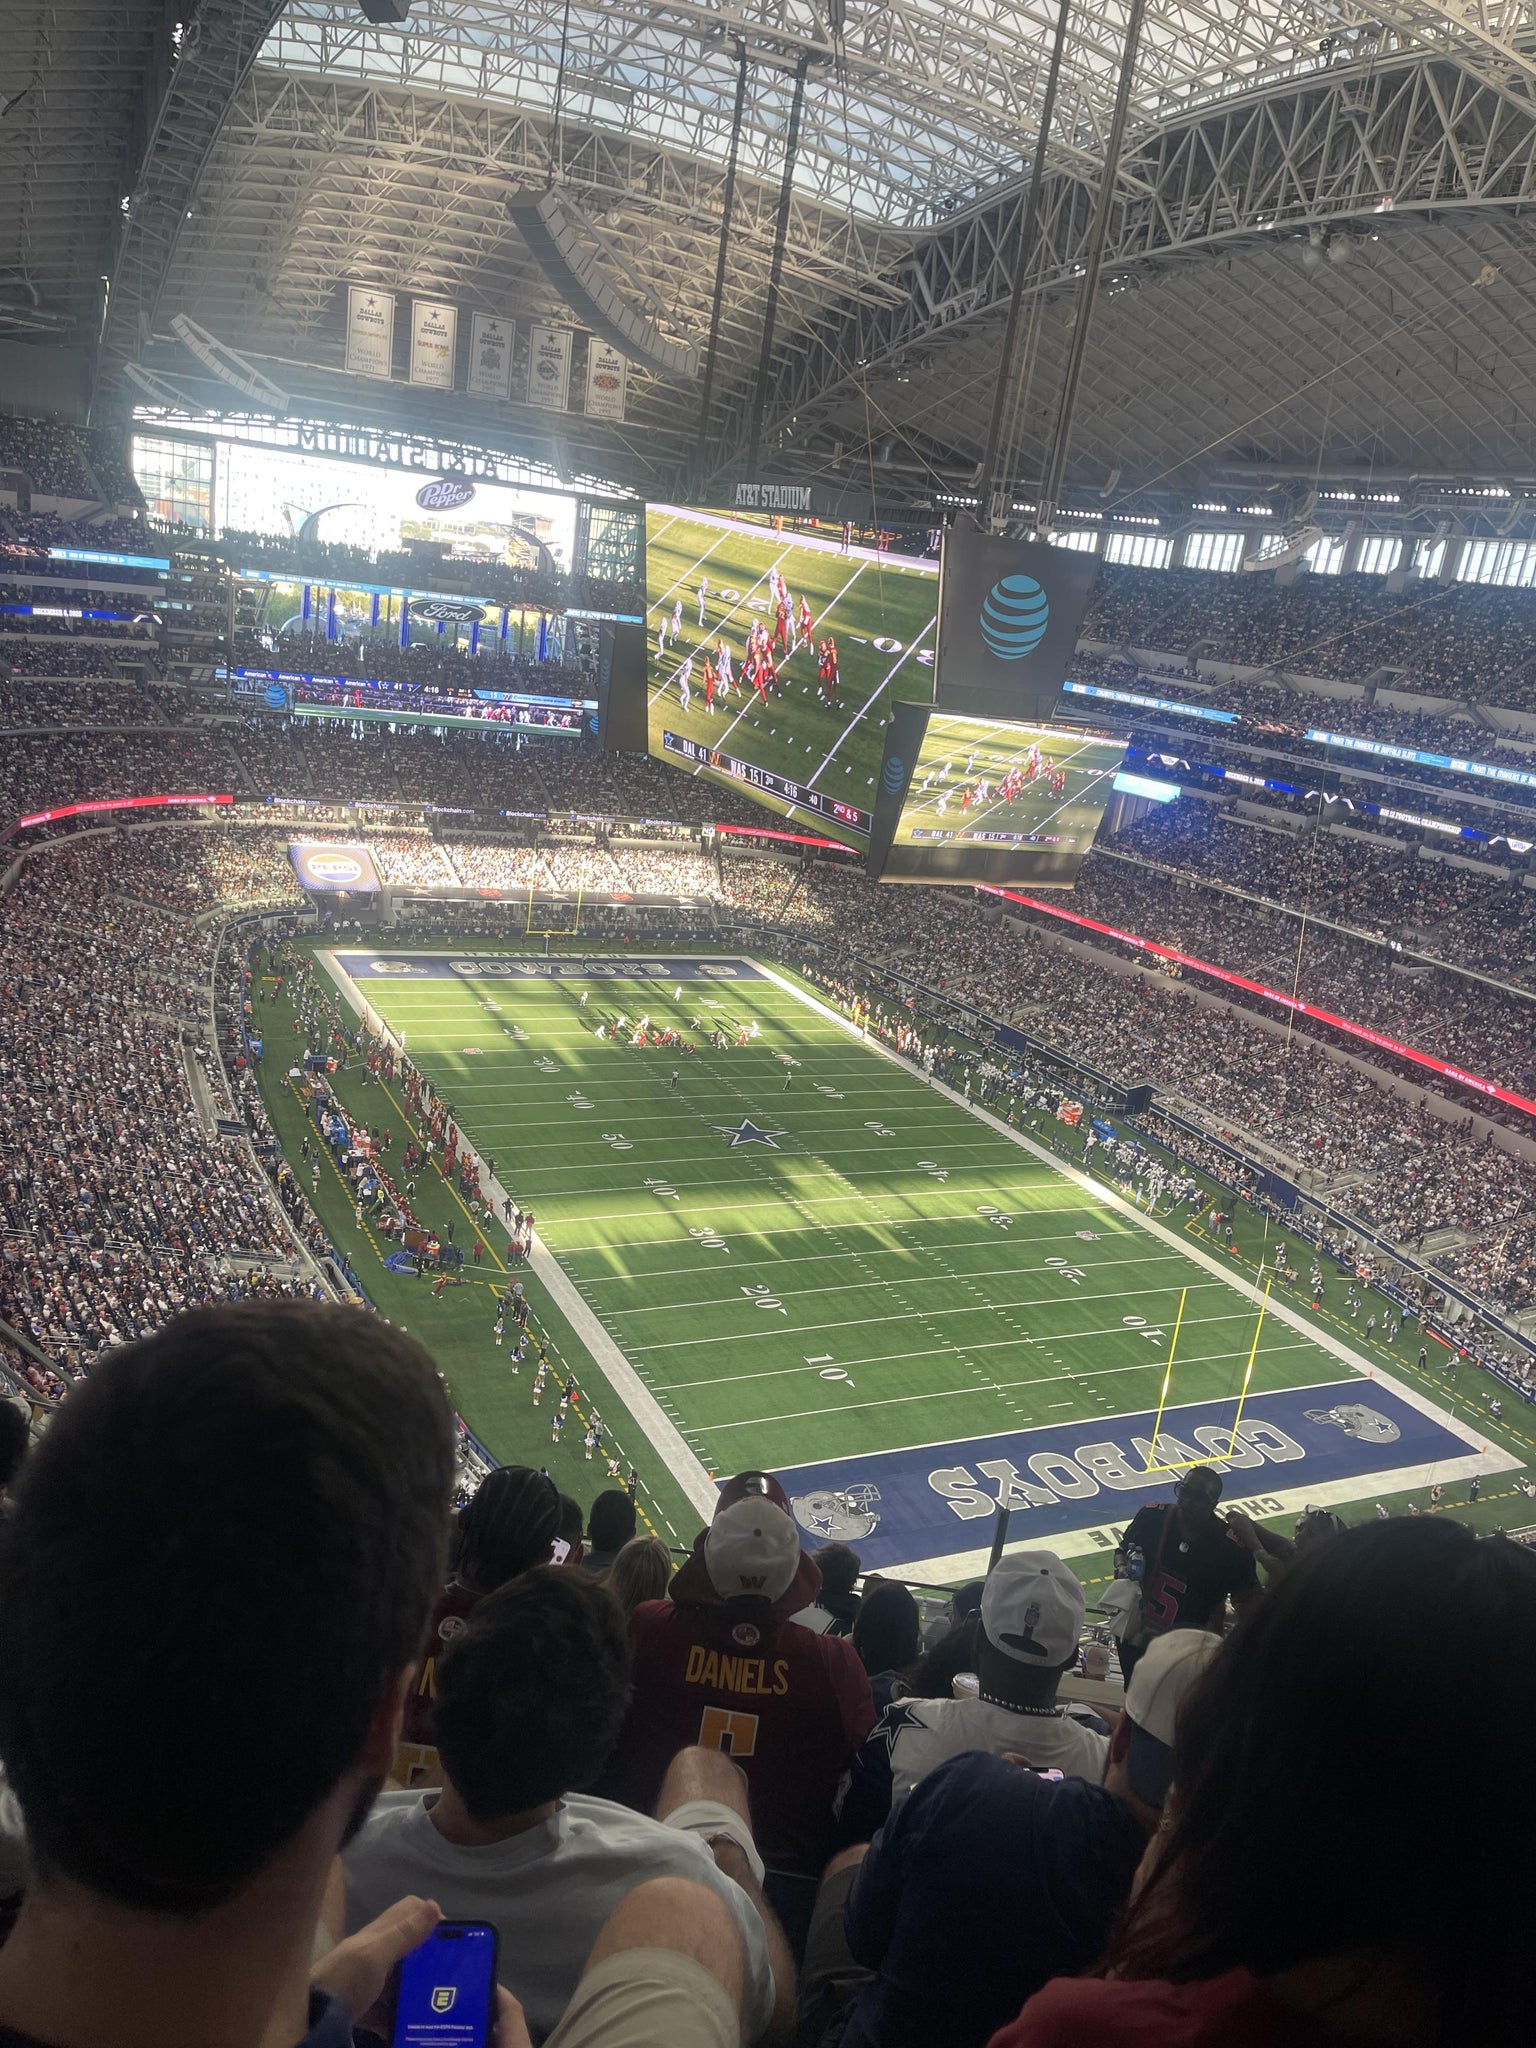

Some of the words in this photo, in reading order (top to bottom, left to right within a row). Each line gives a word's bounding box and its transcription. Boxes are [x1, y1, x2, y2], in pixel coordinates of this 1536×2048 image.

[357, 314, 384, 325] COWBOYS
[360, 308, 382, 318] DALLAS
[420, 327, 448, 337] COWBOYS
[424, 321, 445, 330] DALLAS
[482, 332, 504, 341] DALLAS
[598, 356, 618, 365] DALLAS
[420, 484, 472, 507] Pepper
[440, 482, 462, 495] Dr
[735, 483, 760, 506] AT&T
[761, 485, 811, 511] STADIUM
[423, 603, 472, 621] Ford
[244, 670, 266, 678] American
[394, 683, 402, 691] 41
[424, 686, 439, 694] 4:16
[683, 740, 695, 757] DAL
[699, 747, 707, 761] 41
[730, 760, 747, 777] WAS
[750, 768, 759, 783] 15
[784, 782, 797, 798] 4:16
[432, 807, 475, 815] Blockchain.com
[506, 810, 547, 818] Blockchain.com
[833, 804, 845, 814] 2ND
[846, 809, 852, 819] &
[853, 812, 858, 821] 5
[449, 961, 671, 976] COWBOYS
[533, 1058, 560, 1073] 30
[1444, 1068, 1457, 1079] BANK
[1464, 1076, 1486, 1090] AMERICA
[816, 1086, 846, 1099] 40
[565, 1094, 595, 1109] 40
[864, 1121, 896, 1136] 50
[601, 1133, 634, 1150] 50
[916, 1161, 950, 1179] 40
[643, 1177, 677, 1195] 40
[976, 1206, 1014, 1225] 30
[688, 1227, 726, 1248] 30
[1044, 1257, 1087, 1279] 20
[740, 1284, 782, 1309] 20
[1122, 1316, 1167, 1339] 10
[803, 1353, 848, 1380] 10
[927, 1418, 1305, 1521] COWBOYS
[739, 1575, 767, 1590] W
[685, 1645, 789, 1695] DANIELS
